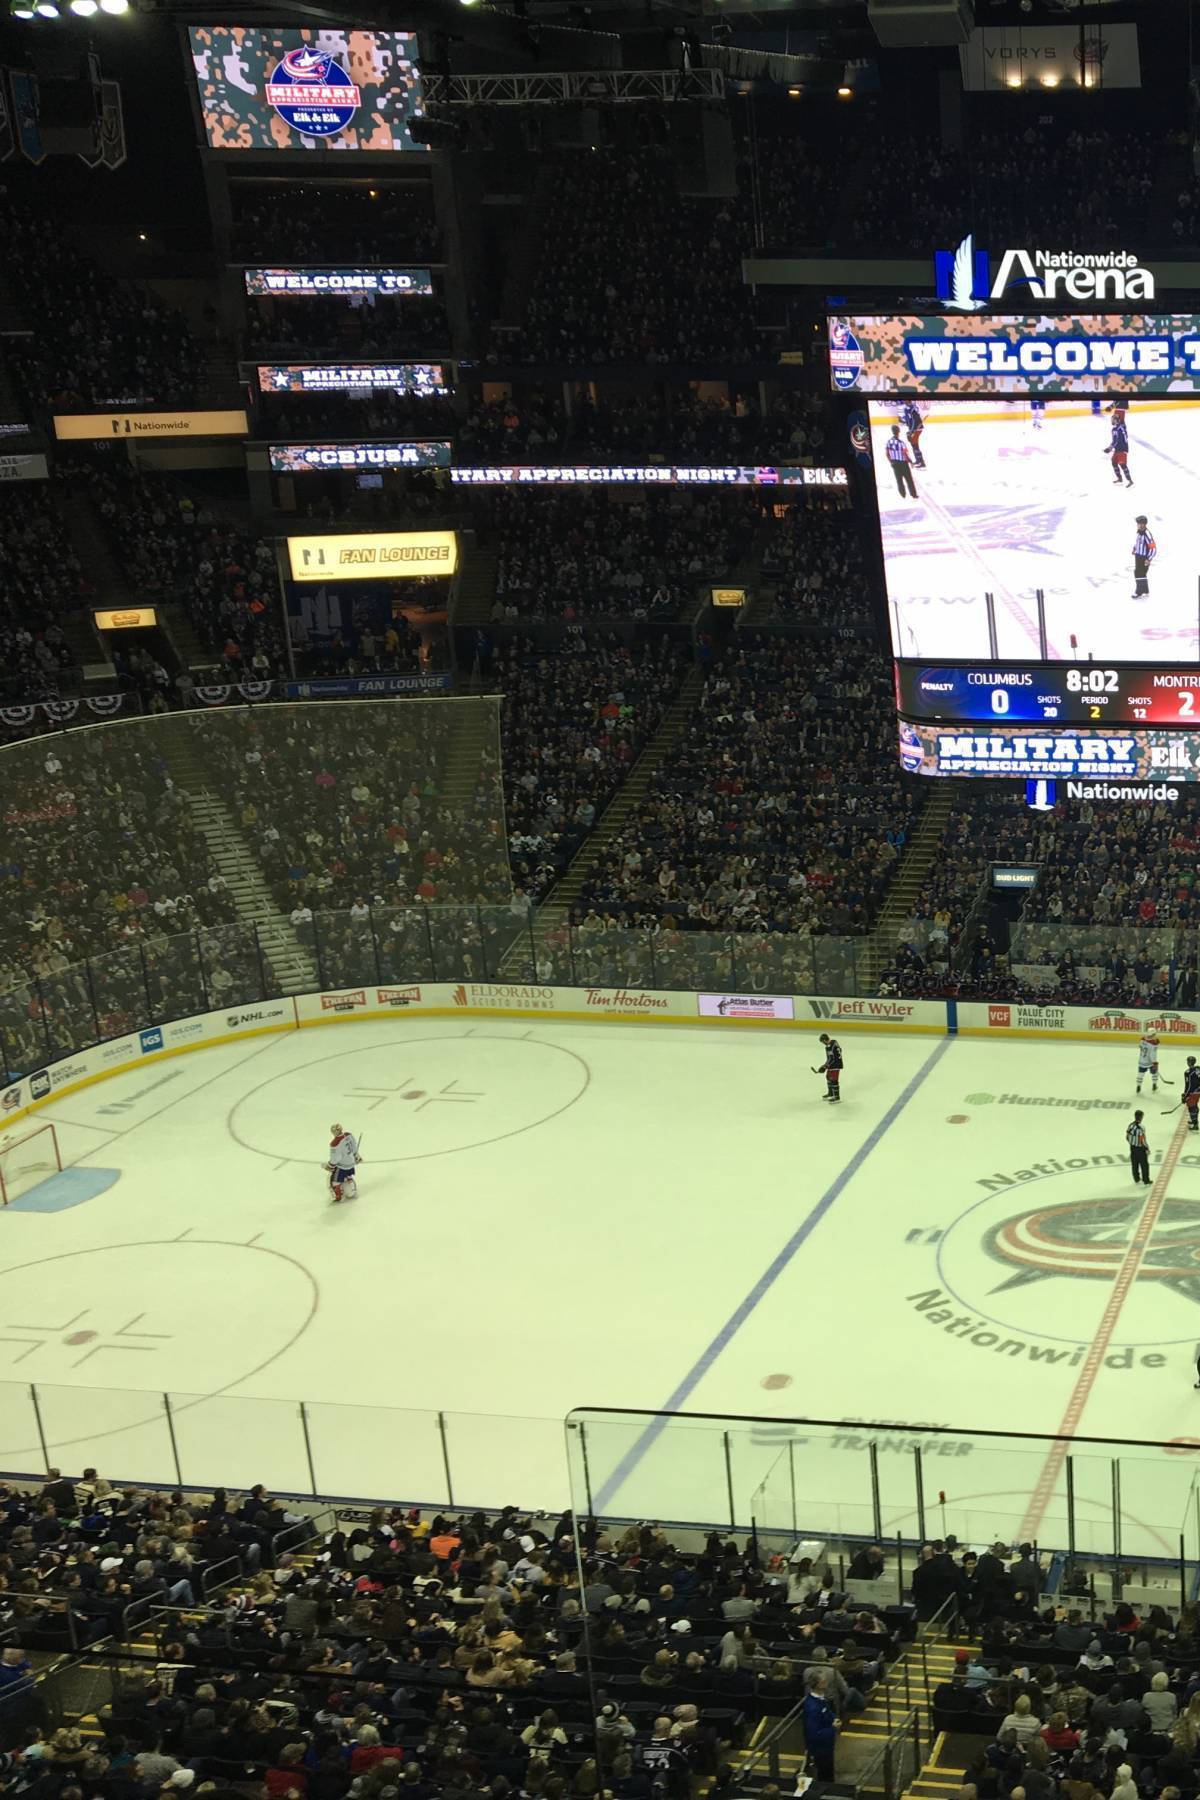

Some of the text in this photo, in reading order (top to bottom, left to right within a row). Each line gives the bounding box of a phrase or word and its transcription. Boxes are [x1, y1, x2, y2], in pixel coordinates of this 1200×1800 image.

[984, 48, 1057, 59] VORYS
[271, 87, 356, 98] MILITARY
[293, 112, 341, 123] Elk & Elk
[1036, 250, 1138, 268] Nationwide
[265, 275, 412, 288] WELCOME TO
[990, 250, 1155, 300] Arena
[908, 341, 1170, 371] WELCOME
[302, 369, 401, 381] MILITARY
[303, 379, 402, 388] APPRECIATION NIGHT
[133, 420, 191, 431] Nationwide
[305, 449, 420, 464] #CBJUSA
[451, 467, 738, 483] ITARY APPRECIATION NIGHT
[803, 466, 832, 484] Elk
[339, 546, 450, 564] FAN LOUNGE
[358, 678, 445, 692] FAN LOUNGE
[967, 673, 1033, 686] COLUMBUS
[1066, 669, 1120, 692] 8:02
[921, 682, 954, 691] PENALTY
[991, 689, 1010, 714] 0
[1037, 695, 1062, 704] SHOTS
[1081, 696, 1109, 705] PERIOD
[1127, 697, 1153, 705] SHOTS
[1177, 691, 1195, 716] 2
[1043, 707, 1058, 718] 20
[1090, 706, 1101, 718] 2
[1133, 708, 1147, 719] 12
[939, 737, 1135, 760] MILITARY
[1151, 746, 1194, 768] Elk
[940, 760, 1136, 774] APPRECIATION NIGHT
[1066, 782, 1179, 801] Nationwide
[996, 874, 1035, 883] BUD LIGHT
[471, 985, 554, 1000] ELDORADO
[584, 989, 668, 1008] Tim Hortons
[750, 999, 775, 1007] Butler
[837, 1000, 915, 1017] Jeff Wyler
[989, 1010, 1010, 1021] VCF
[1017, 1007, 1065, 1018] VALUE CITY
[1017, 1018, 1066, 1029] FURNITURE
[143, 1034, 161, 1047] IGS
[998, 1094, 1132, 1111] Huntington
[906, 1287, 1168, 1371] Nationwide
[831, 1433, 974, 1458] TRANSFER
